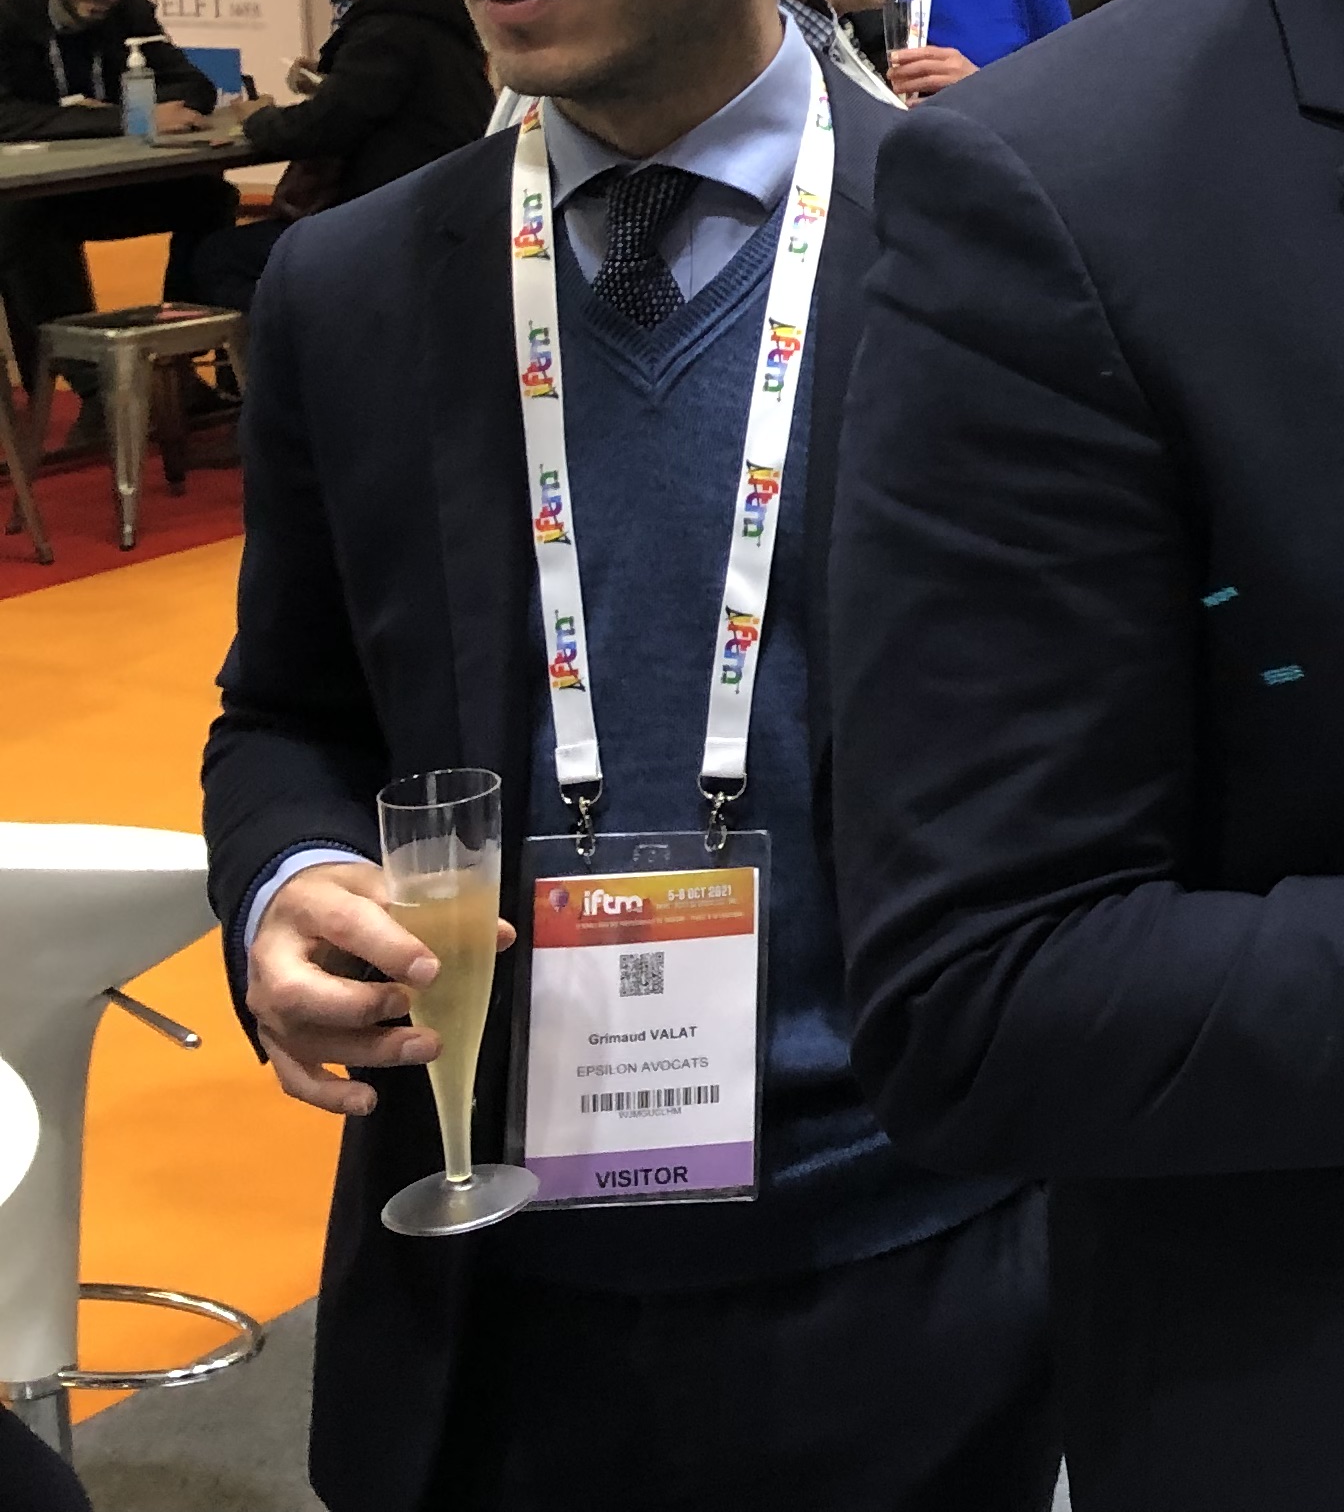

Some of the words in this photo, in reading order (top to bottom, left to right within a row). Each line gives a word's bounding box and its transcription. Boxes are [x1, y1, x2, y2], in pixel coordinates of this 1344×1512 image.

[522, 325, 559, 399] iftm
[763, 317, 803, 394] iftm
[535, 469, 571, 545] iftm
[742, 459, 781, 538] iftm
[550, 615, 586, 692] iftm
[721, 605, 761, 686] iftm
[582, 889, 644, 917] iftm
[707, 884, 732, 898] 2021
[576, 1062, 638, 1078] EPSILON
[641, 1056, 710, 1073] AVOCATS
[588, 1030, 647, 1046] Grimaud
[650, 1025, 698, 1041] VALAT
[595, 1165, 689, 1189] VISITOR
